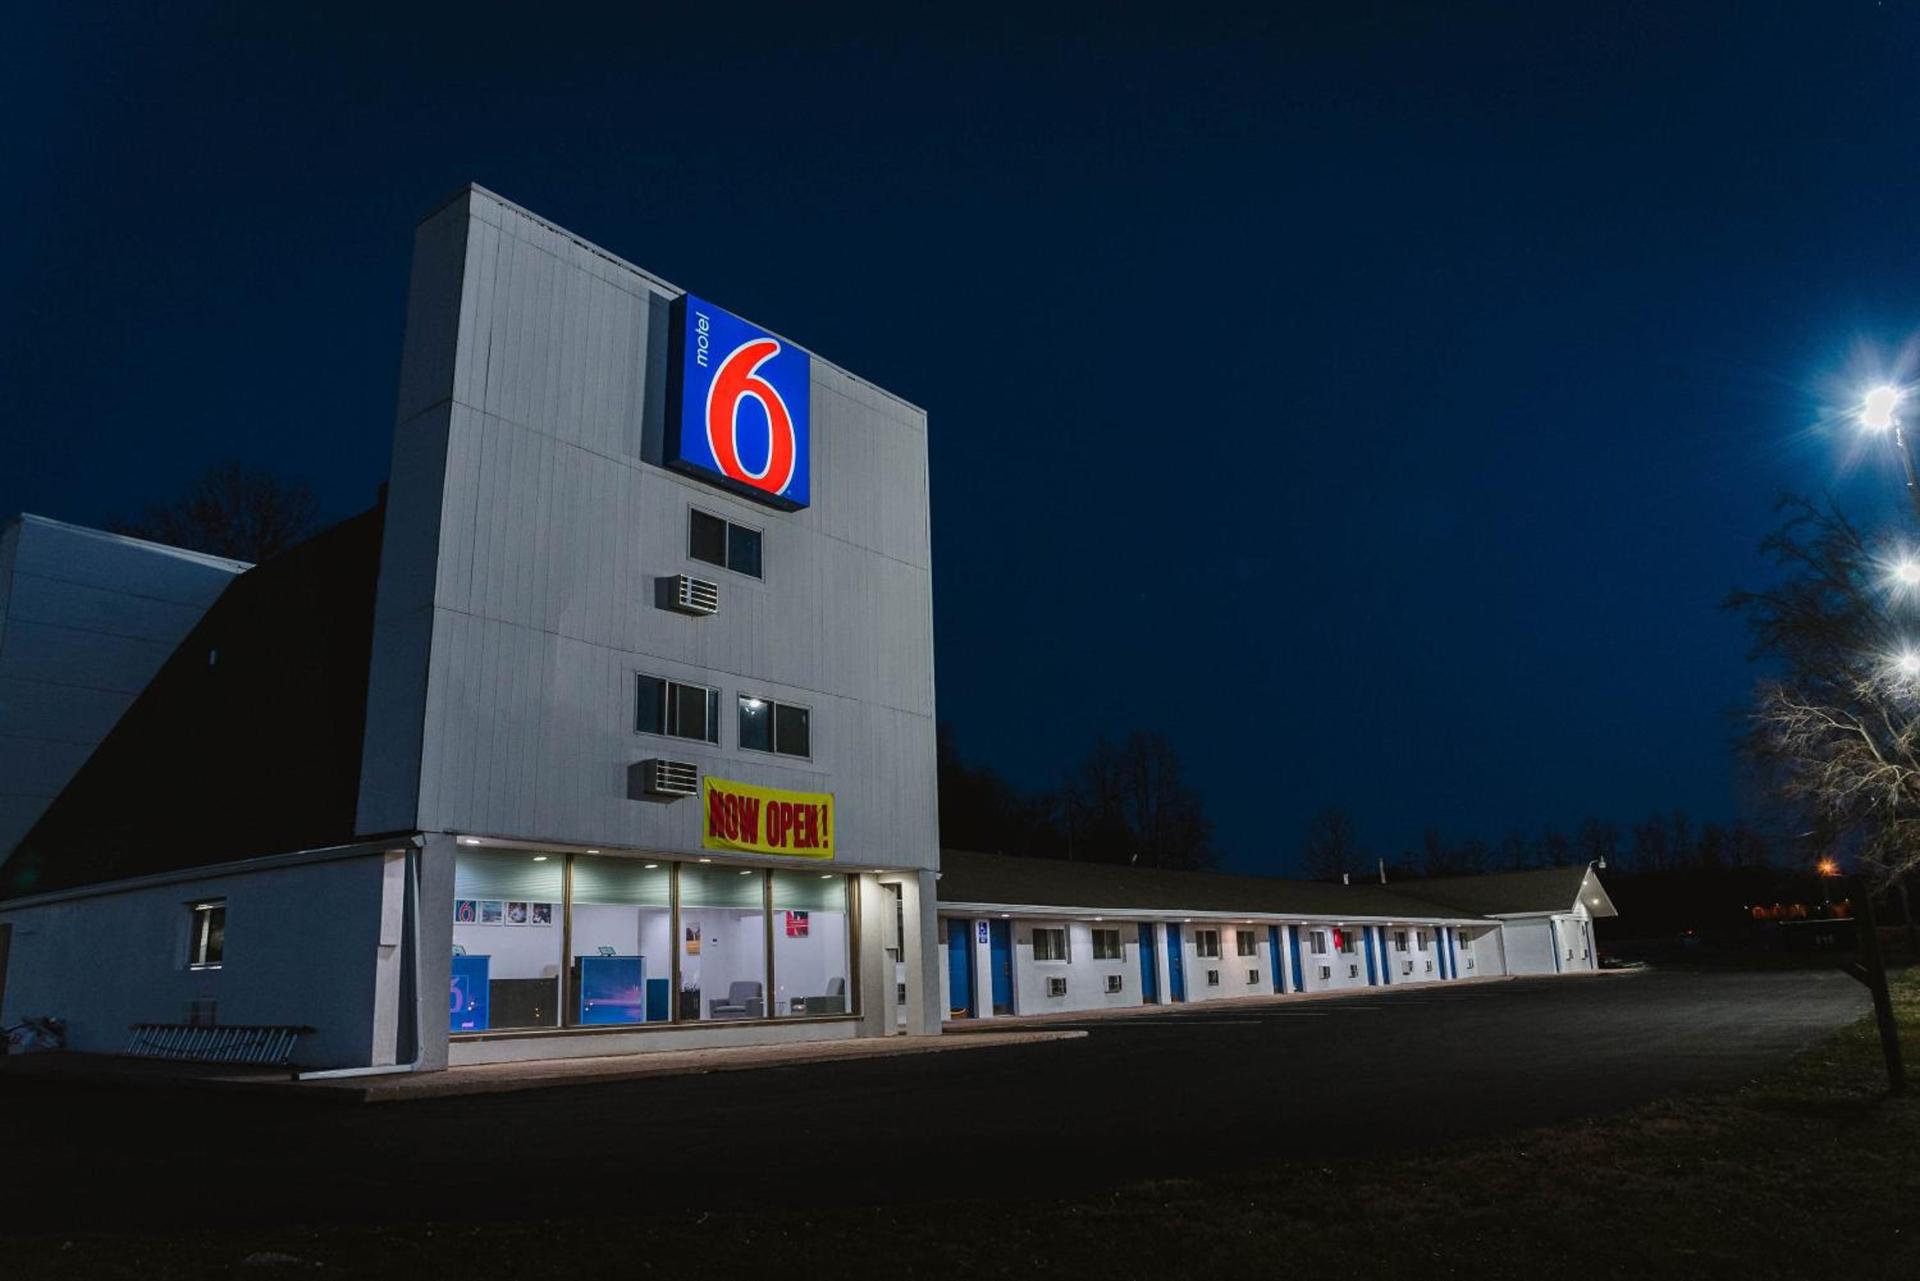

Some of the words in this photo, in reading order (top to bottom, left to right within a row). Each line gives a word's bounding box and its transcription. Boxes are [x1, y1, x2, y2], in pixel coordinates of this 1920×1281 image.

[696, 311, 710, 367] motel
[705, 337, 796, 496] 6
[709, 788, 760, 844] NOW
[766, 800, 828, 848] OPEN!
